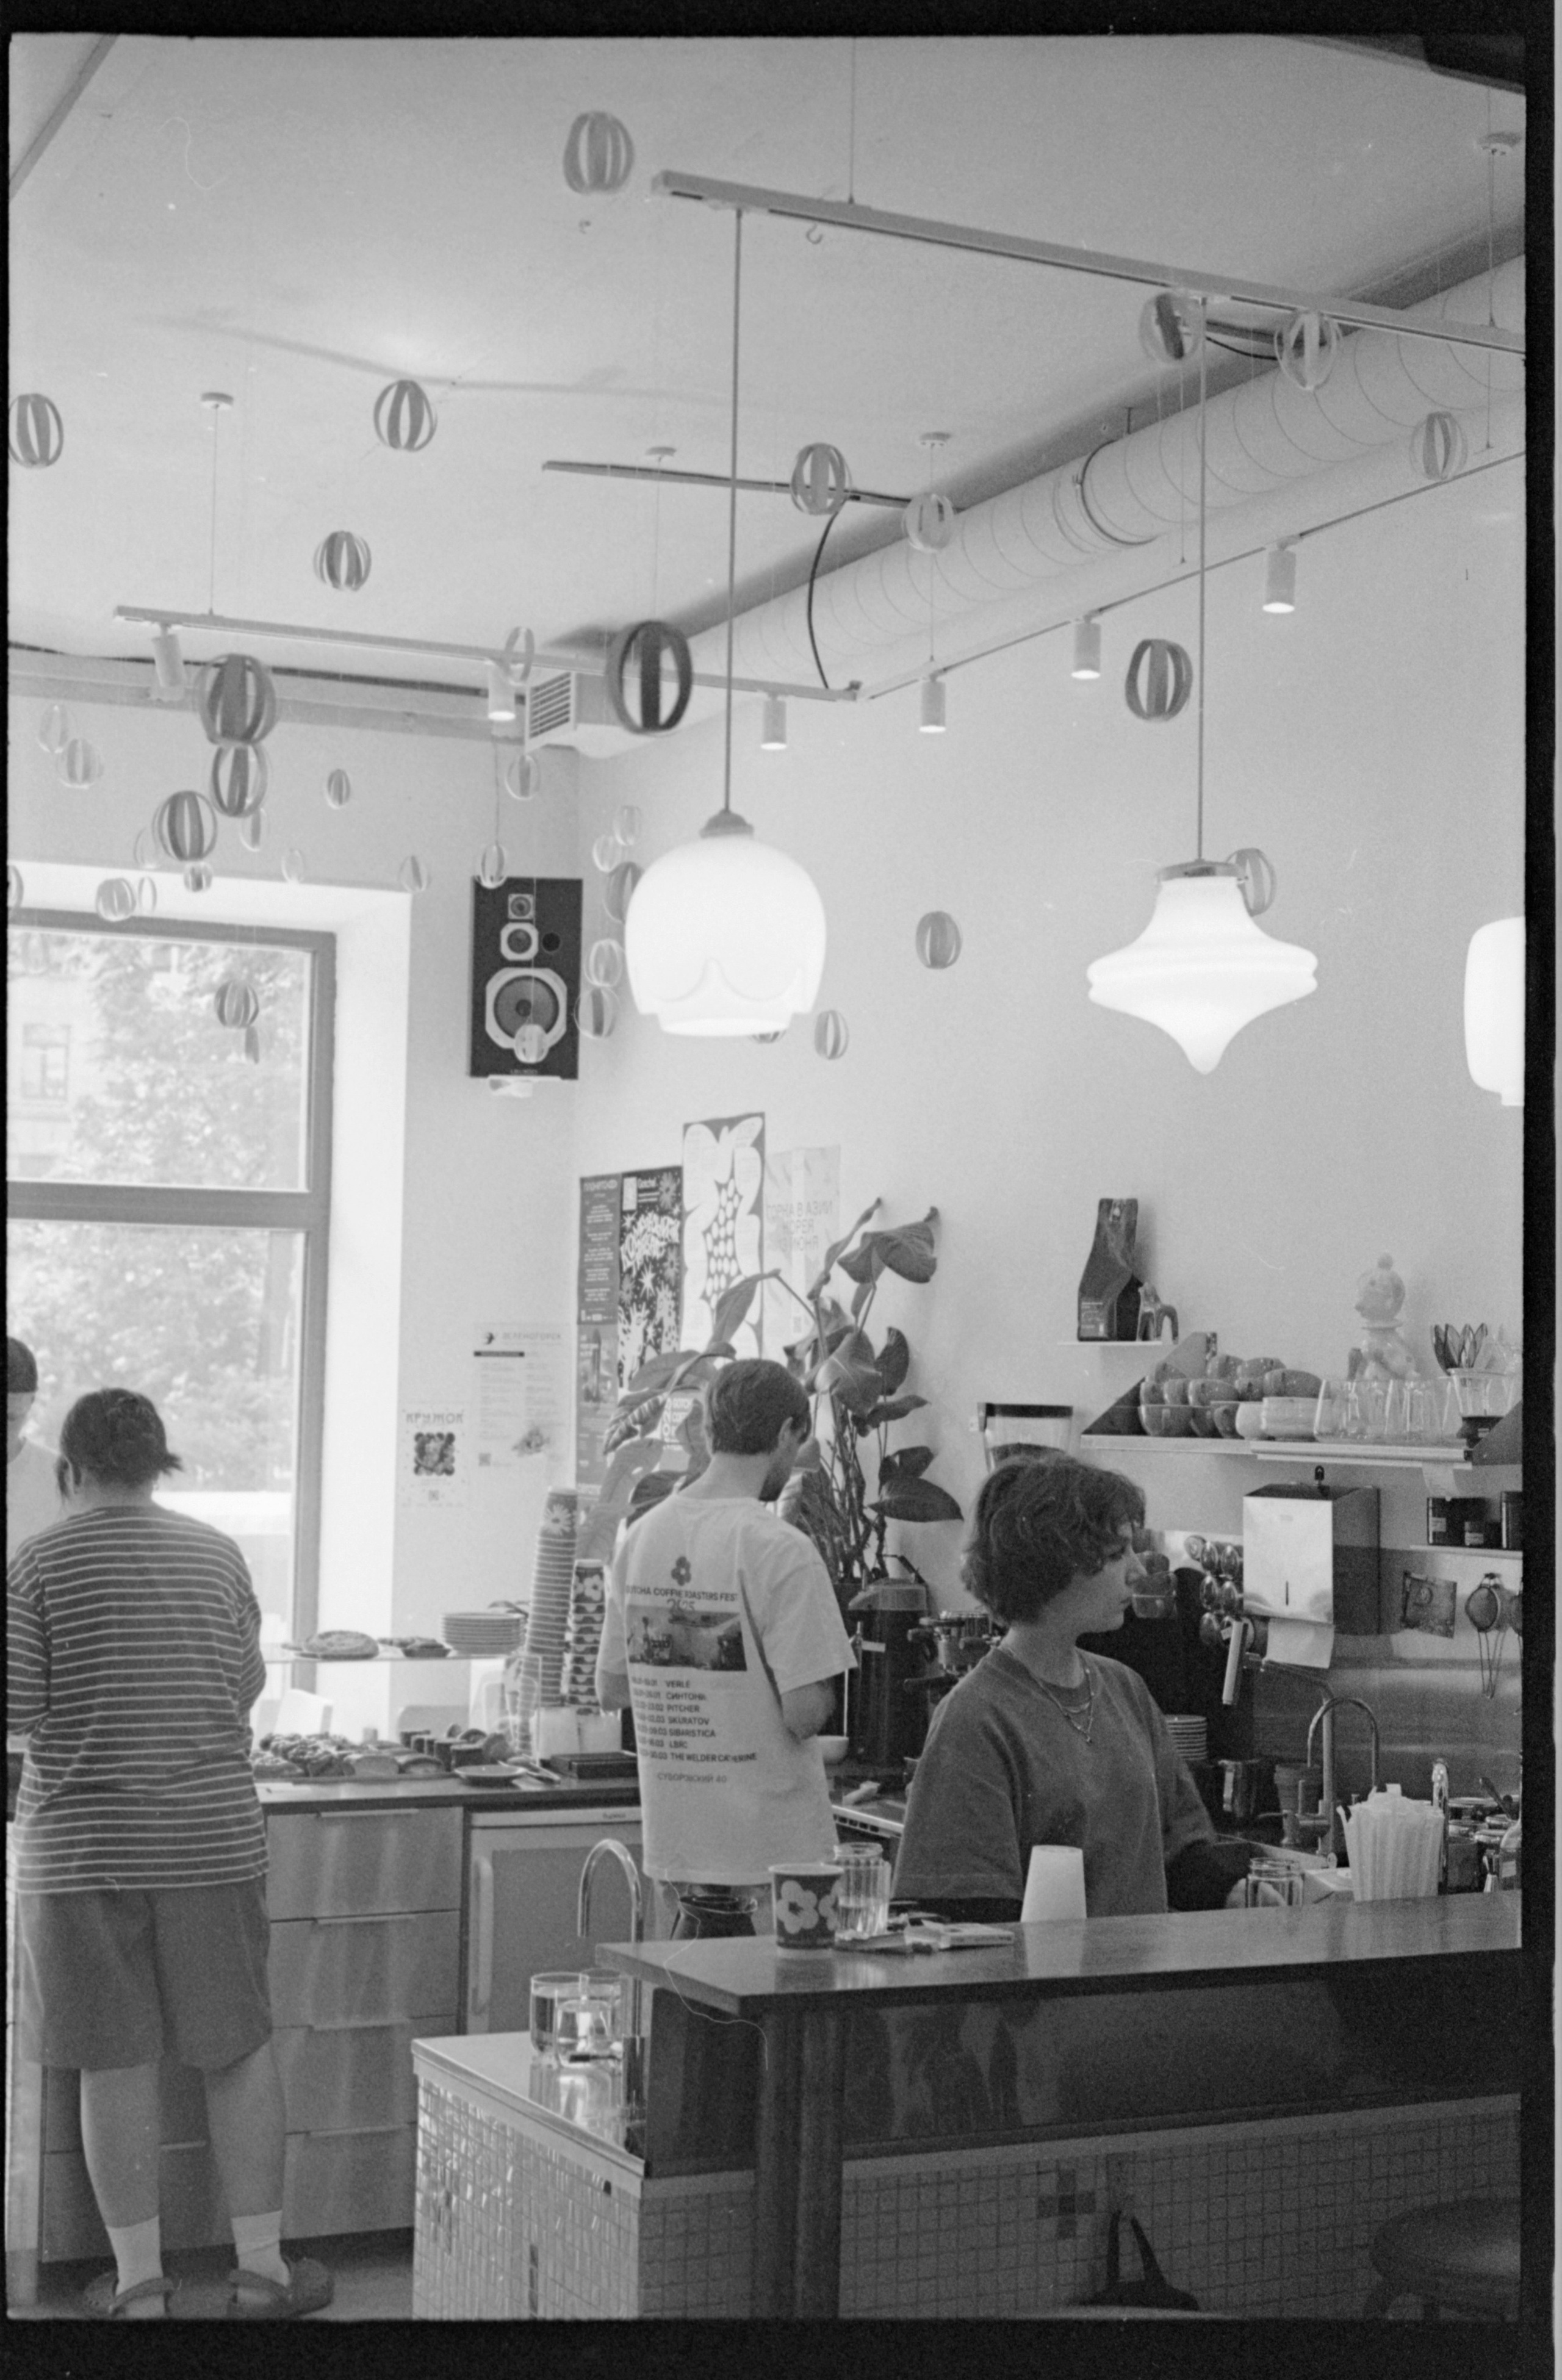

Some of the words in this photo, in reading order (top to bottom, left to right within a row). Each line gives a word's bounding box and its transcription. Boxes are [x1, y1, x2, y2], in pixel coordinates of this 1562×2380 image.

[406, 1412, 463, 1424] КРУЖОК
[666, 1703, 700, 1713] PITCHER
[670, 1752, 684, 1761] THE
[686, 1753, 716, 1762] WELDER
